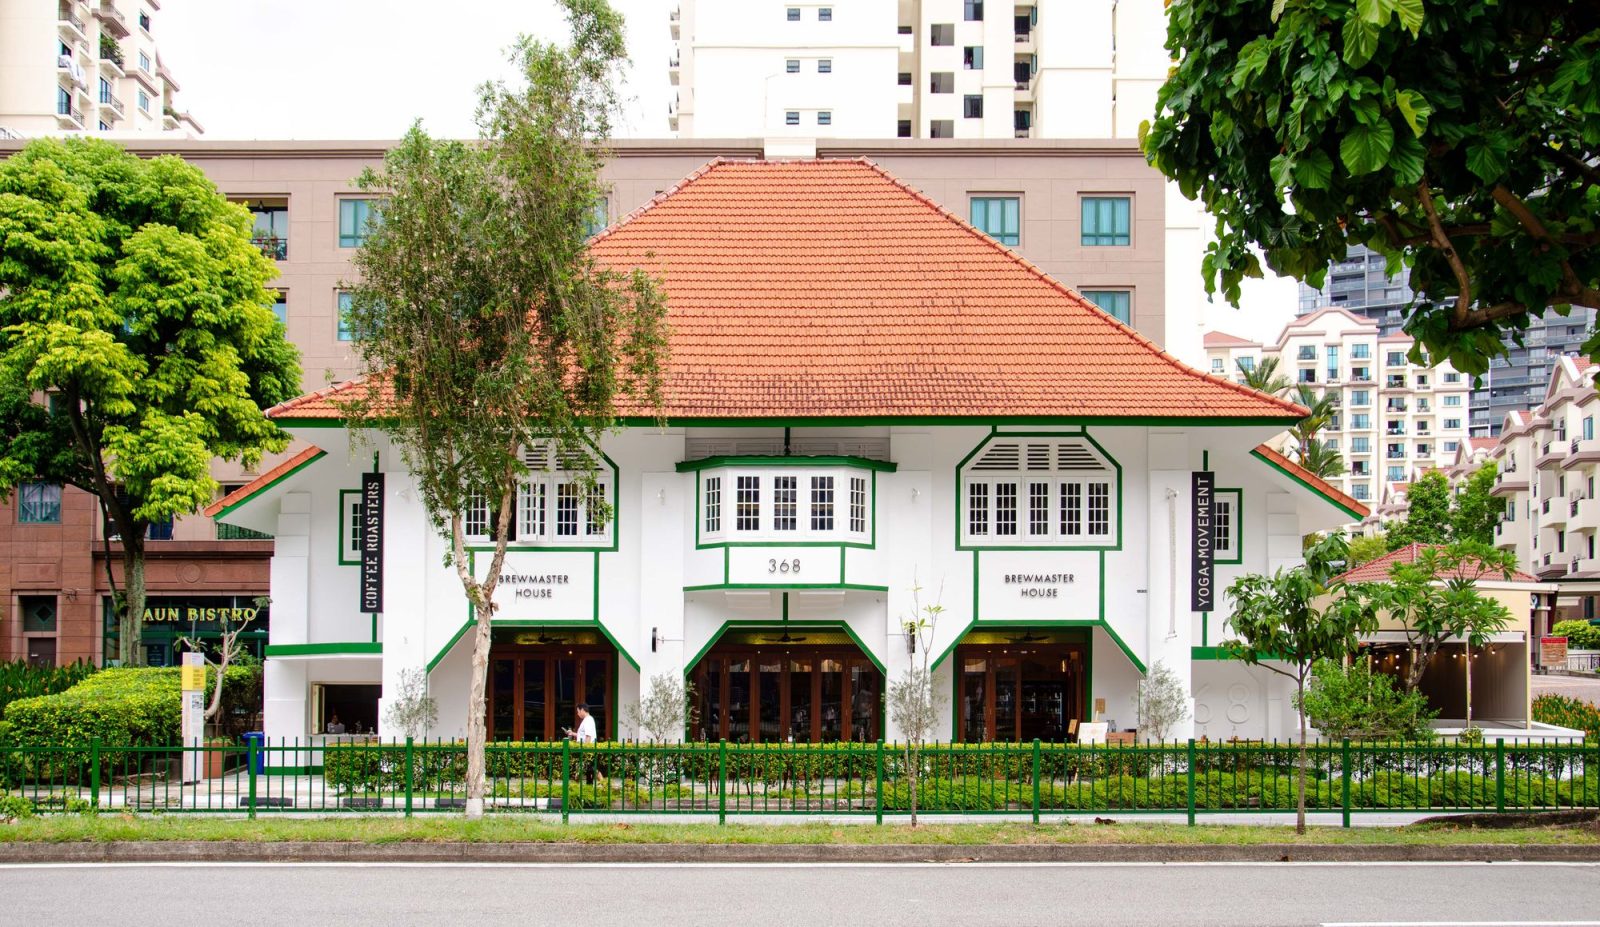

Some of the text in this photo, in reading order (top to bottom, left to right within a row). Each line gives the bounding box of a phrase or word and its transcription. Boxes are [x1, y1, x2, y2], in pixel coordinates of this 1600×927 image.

[365, 481, 379, 609] COFFEE ROASTERS
[768, 558, 801, 573] 368
[498, 574, 569, 584] BREWMASTER
[1004, 574, 1074, 584] BREWMASTER
[515, 588, 553, 598] HOUSE
[1021, 588, 1058, 598] HOUSE
[187, 607, 256, 622] BISTRO
